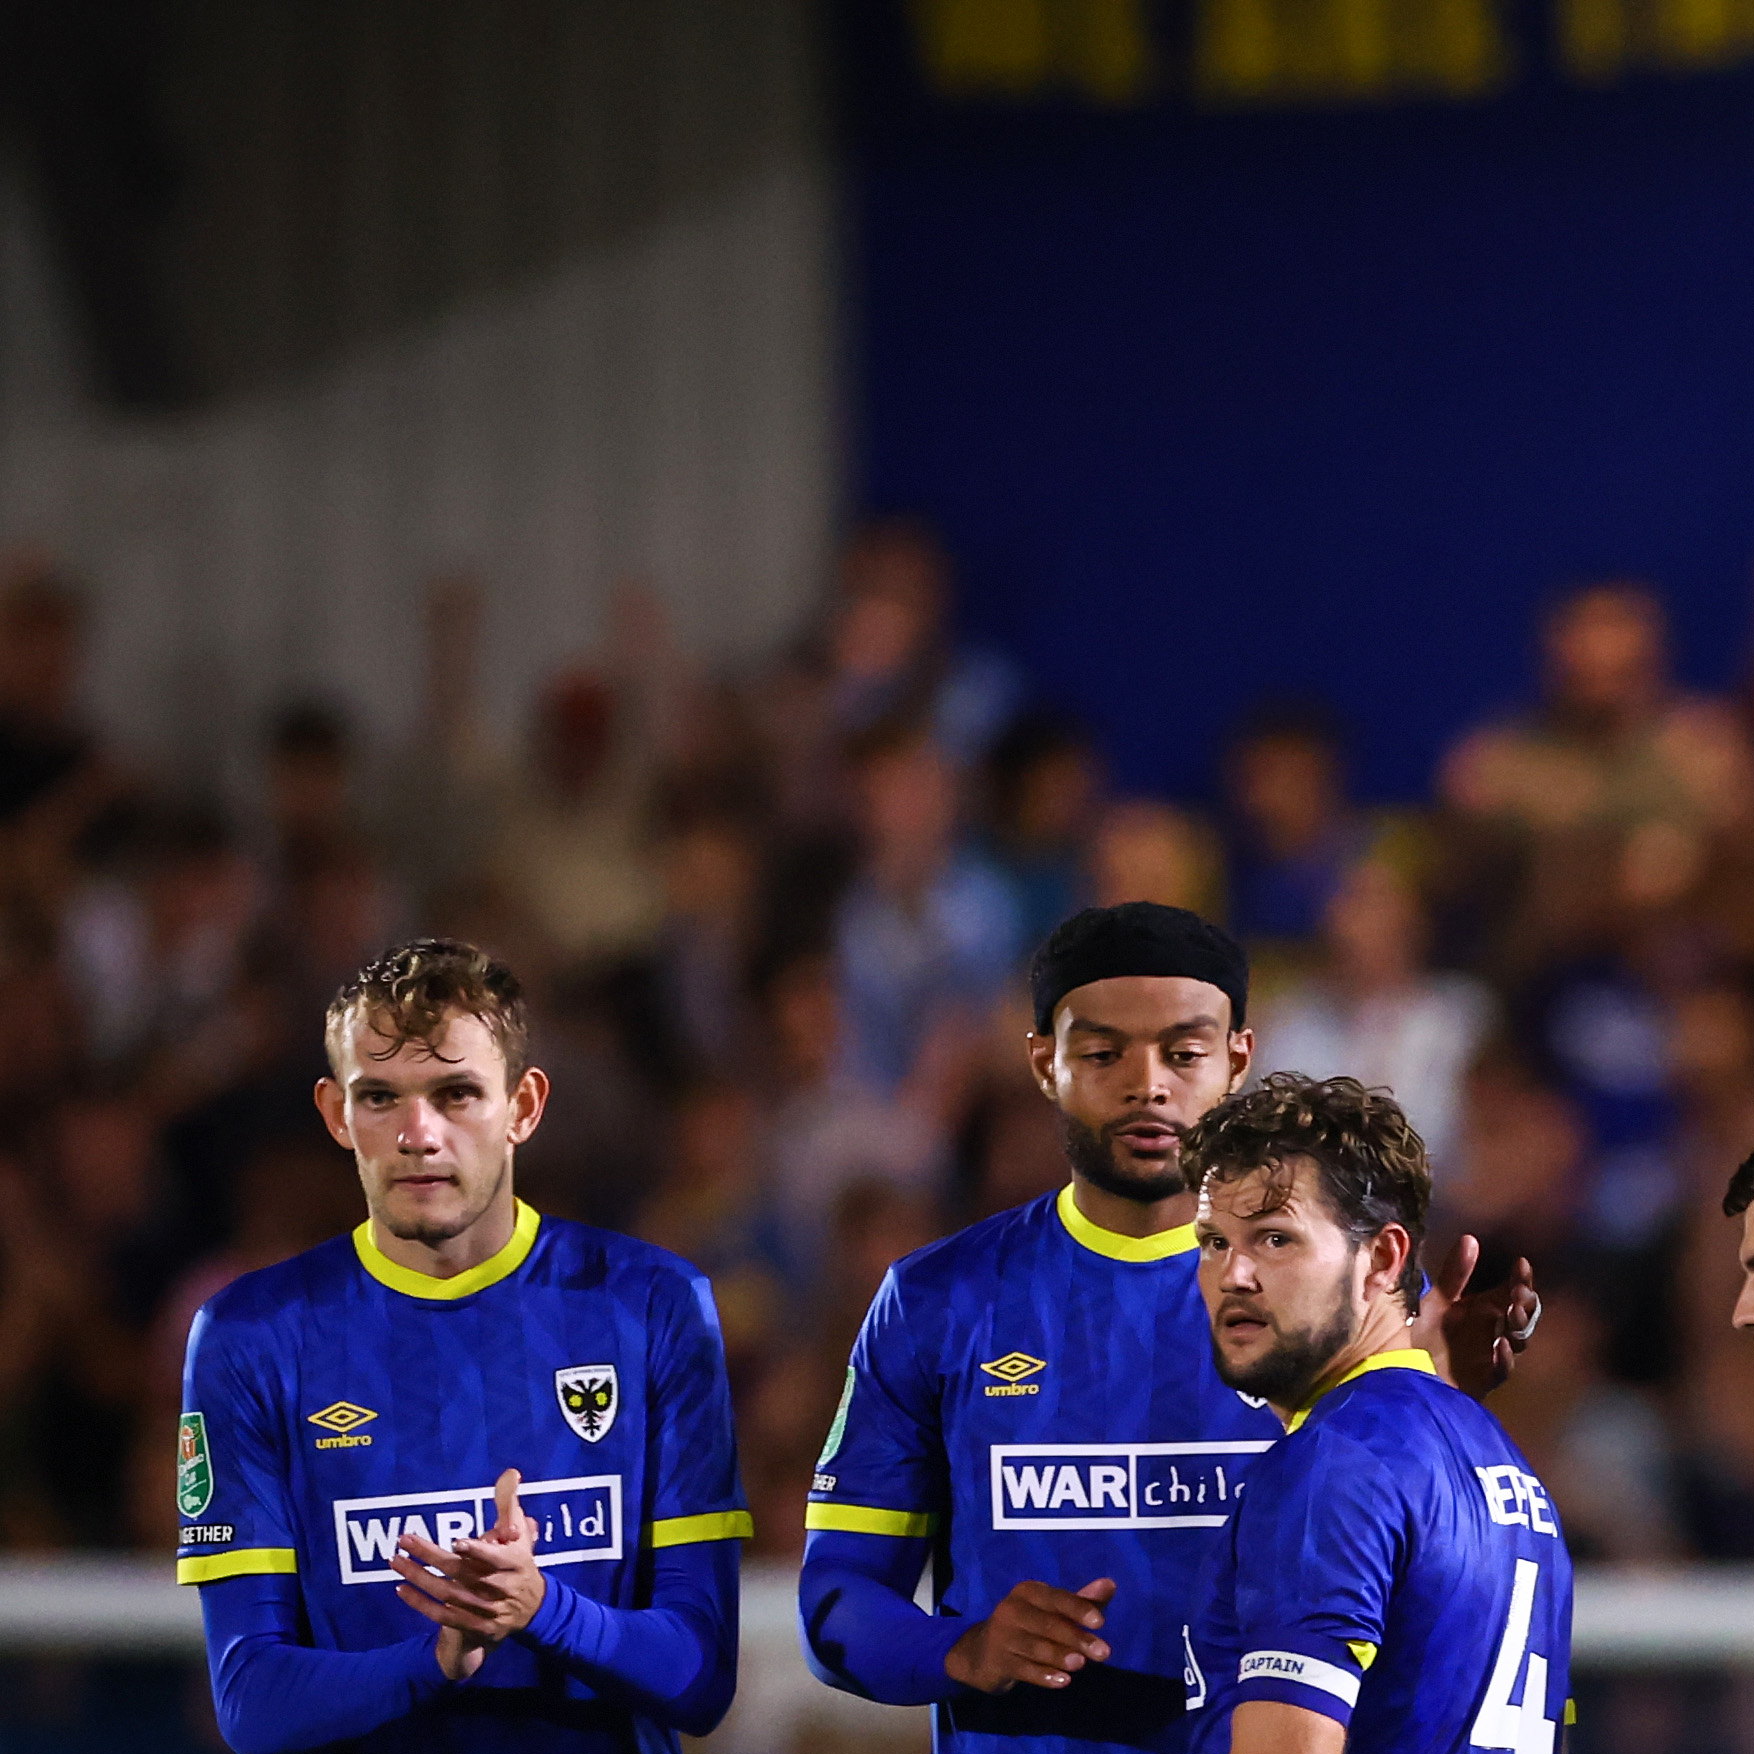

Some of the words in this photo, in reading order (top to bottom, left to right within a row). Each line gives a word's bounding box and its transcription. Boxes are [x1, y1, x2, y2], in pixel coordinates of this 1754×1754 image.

[985, 1381, 1040, 1397] umbro
[315, 1433, 373, 1450] umbro
[1001, 1465, 1129, 1509] WAR
[545, 1499, 605, 1542] ild
[1243, 1656, 1305, 1675] CAPTAIN
